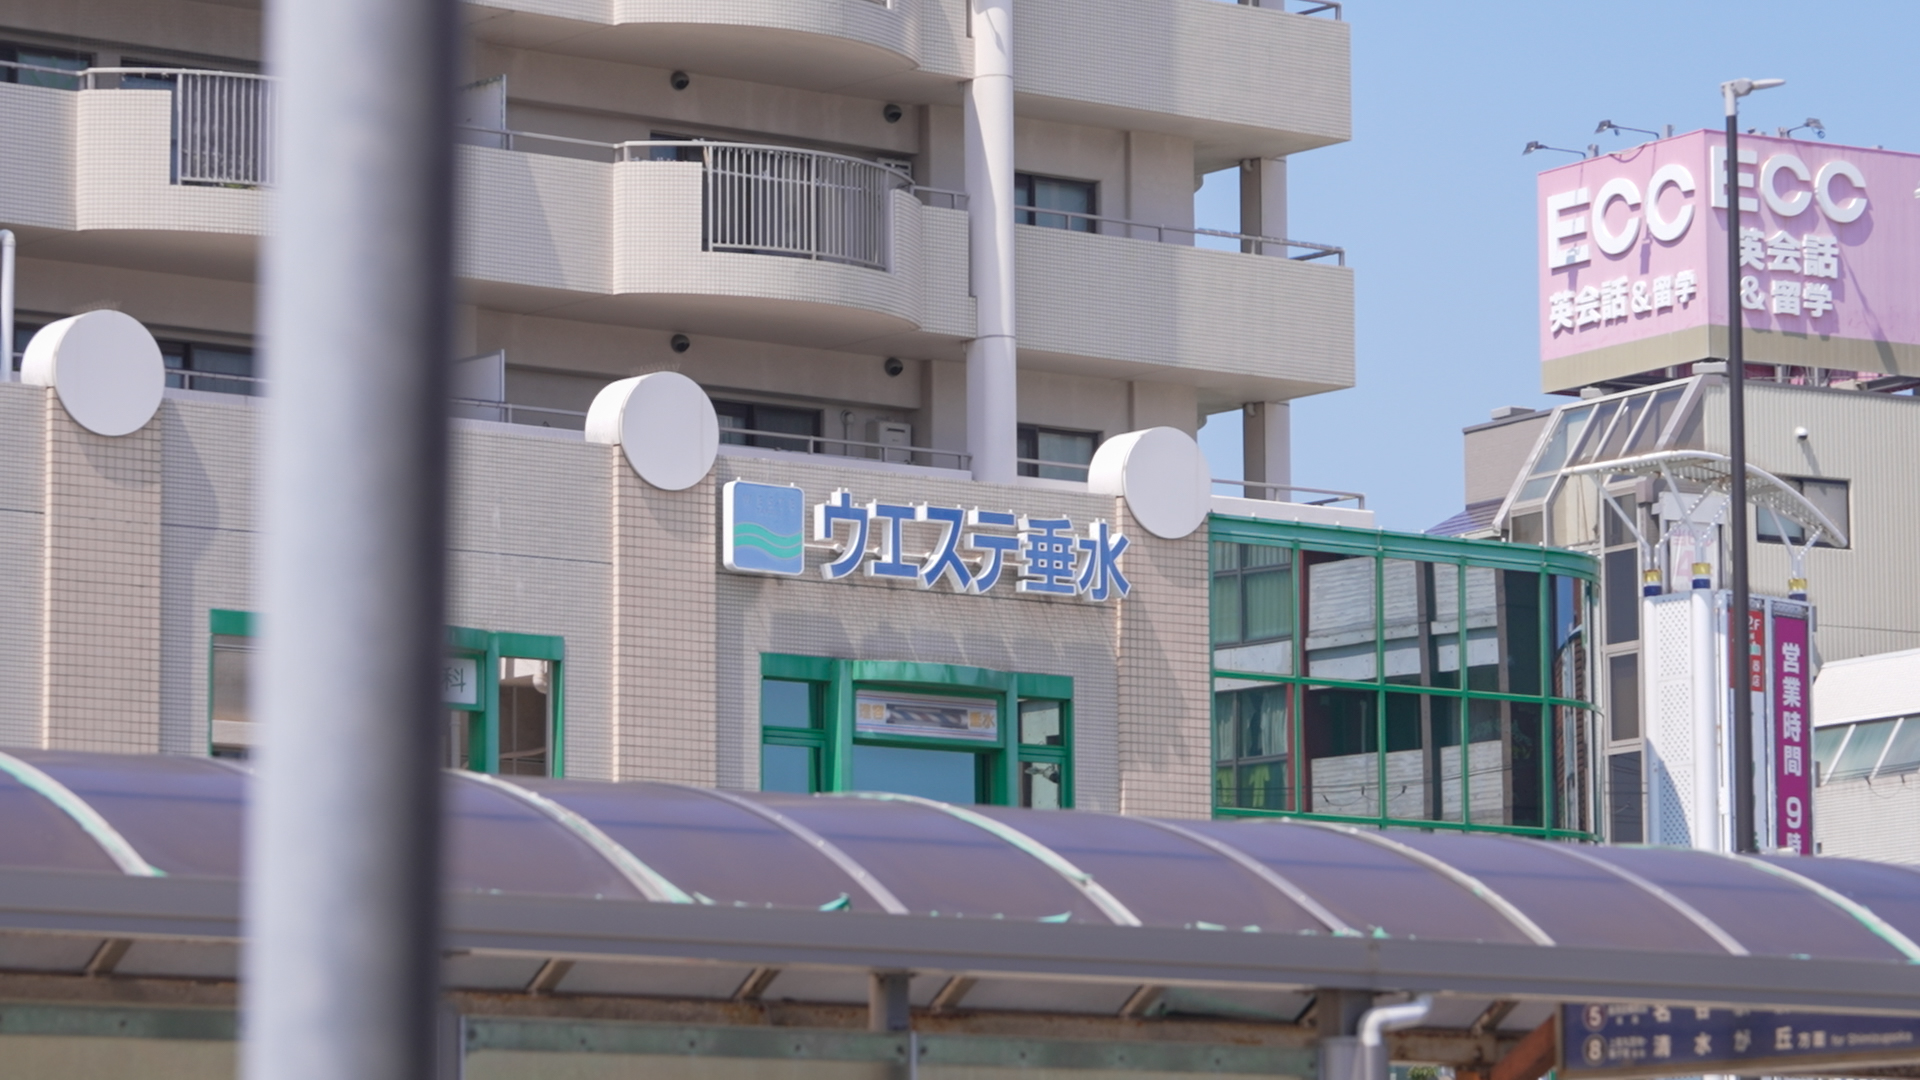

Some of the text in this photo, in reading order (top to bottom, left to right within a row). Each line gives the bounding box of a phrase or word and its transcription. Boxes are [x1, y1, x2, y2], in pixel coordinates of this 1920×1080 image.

[1547, 163, 1696, 269] ECC
[1710, 145, 1868, 223] ECC
[1739, 227, 1839, 280] 英会話
[1549, 269, 1698, 334] 英会話&留学
[1740, 275, 1833, 318] &留学
[814, 488, 1131, 602] ウエステ垂水
[1782, 642, 1802, 777] 営業時間
[1588, 1038, 1602, 1060] 8
